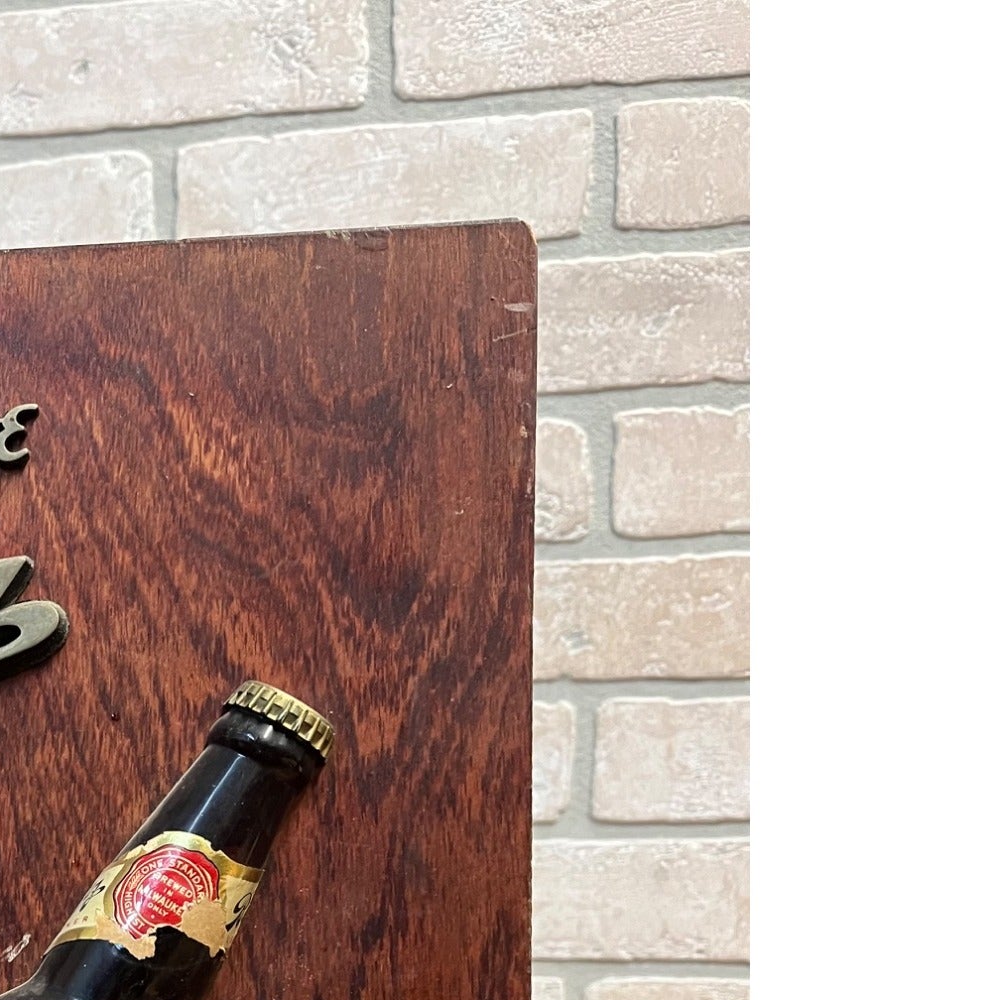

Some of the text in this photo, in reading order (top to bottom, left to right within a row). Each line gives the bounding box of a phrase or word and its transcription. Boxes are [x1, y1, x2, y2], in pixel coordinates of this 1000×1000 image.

[140, 859, 206, 905] ONE STANDAR
[151, 871, 194, 899] BREWED
[163, 888, 175, 897] IN
[147, 902, 169, 917] ONLY
